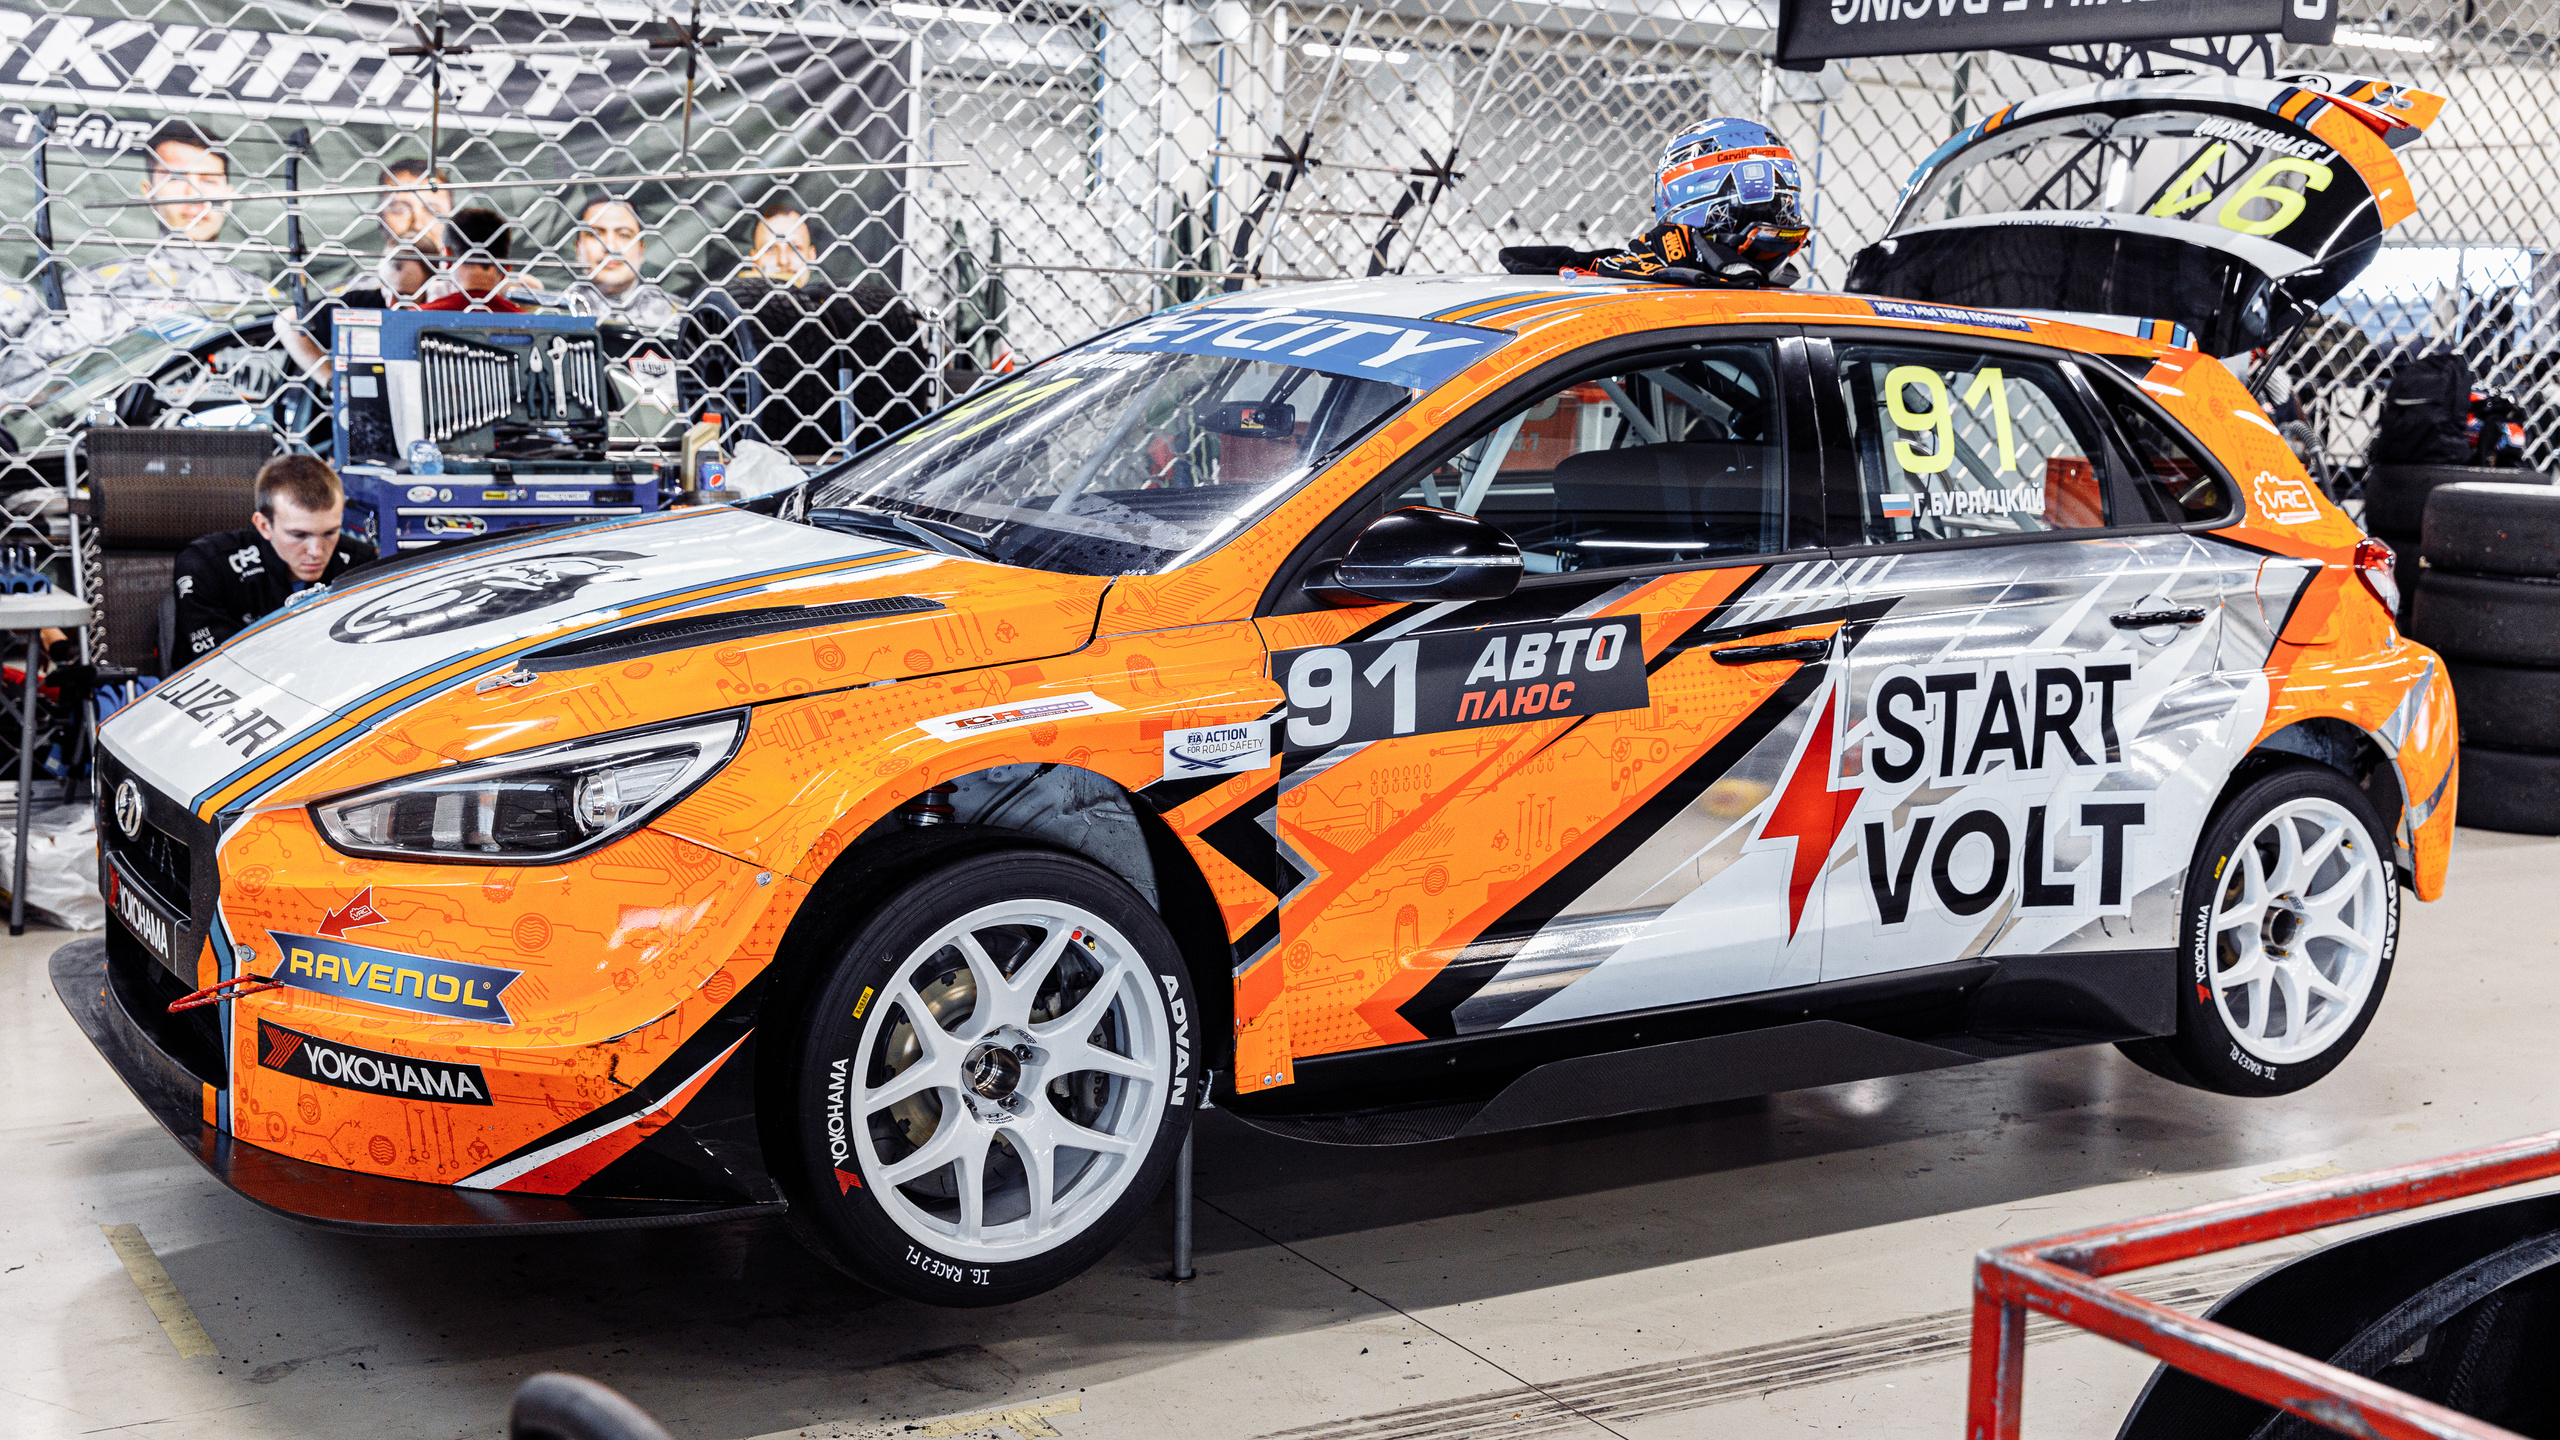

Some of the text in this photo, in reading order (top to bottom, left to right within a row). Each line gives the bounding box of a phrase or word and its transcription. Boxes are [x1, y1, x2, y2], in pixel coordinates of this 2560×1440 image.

[2193, 117, 2340, 166] Г.БУРЛУЦКИЙ
[2149, 144, 2334, 236] 91
[1885, 365, 2017, 474] 91
[1913, 482, 2047, 519] Г.БУРЛУЦКИЙ
[2263, 489, 2308, 509] VRC
[192, 636, 216, 654] OLT
[1464, 623, 1627, 686] АВТО
[945, 710, 1024, 728] TCR
[1287, 639, 1420, 747] 91
[1456, 681, 1576, 722] ПЛЮС
[1872, 663, 2132, 784] START
[1187, 738, 1265, 754] FOR ROAD SAFETY
[1205, 728, 1248, 743] ACTION
[1864, 802, 2146, 926] VOLT
[119, 878, 170, 960] YOKOHAMA
[2382, 860, 2398, 960] ADVAN
[2194, 904, 2211, 984] YOKOHAMA
[289, 948, 489, 1009] RAVENOL
[303, 1042, 484, 1100] YOKOHAMA
[1160, 974, 1190, 1107] ADVAN
[827, 1057, 850, 1168] YOKOHAMA
